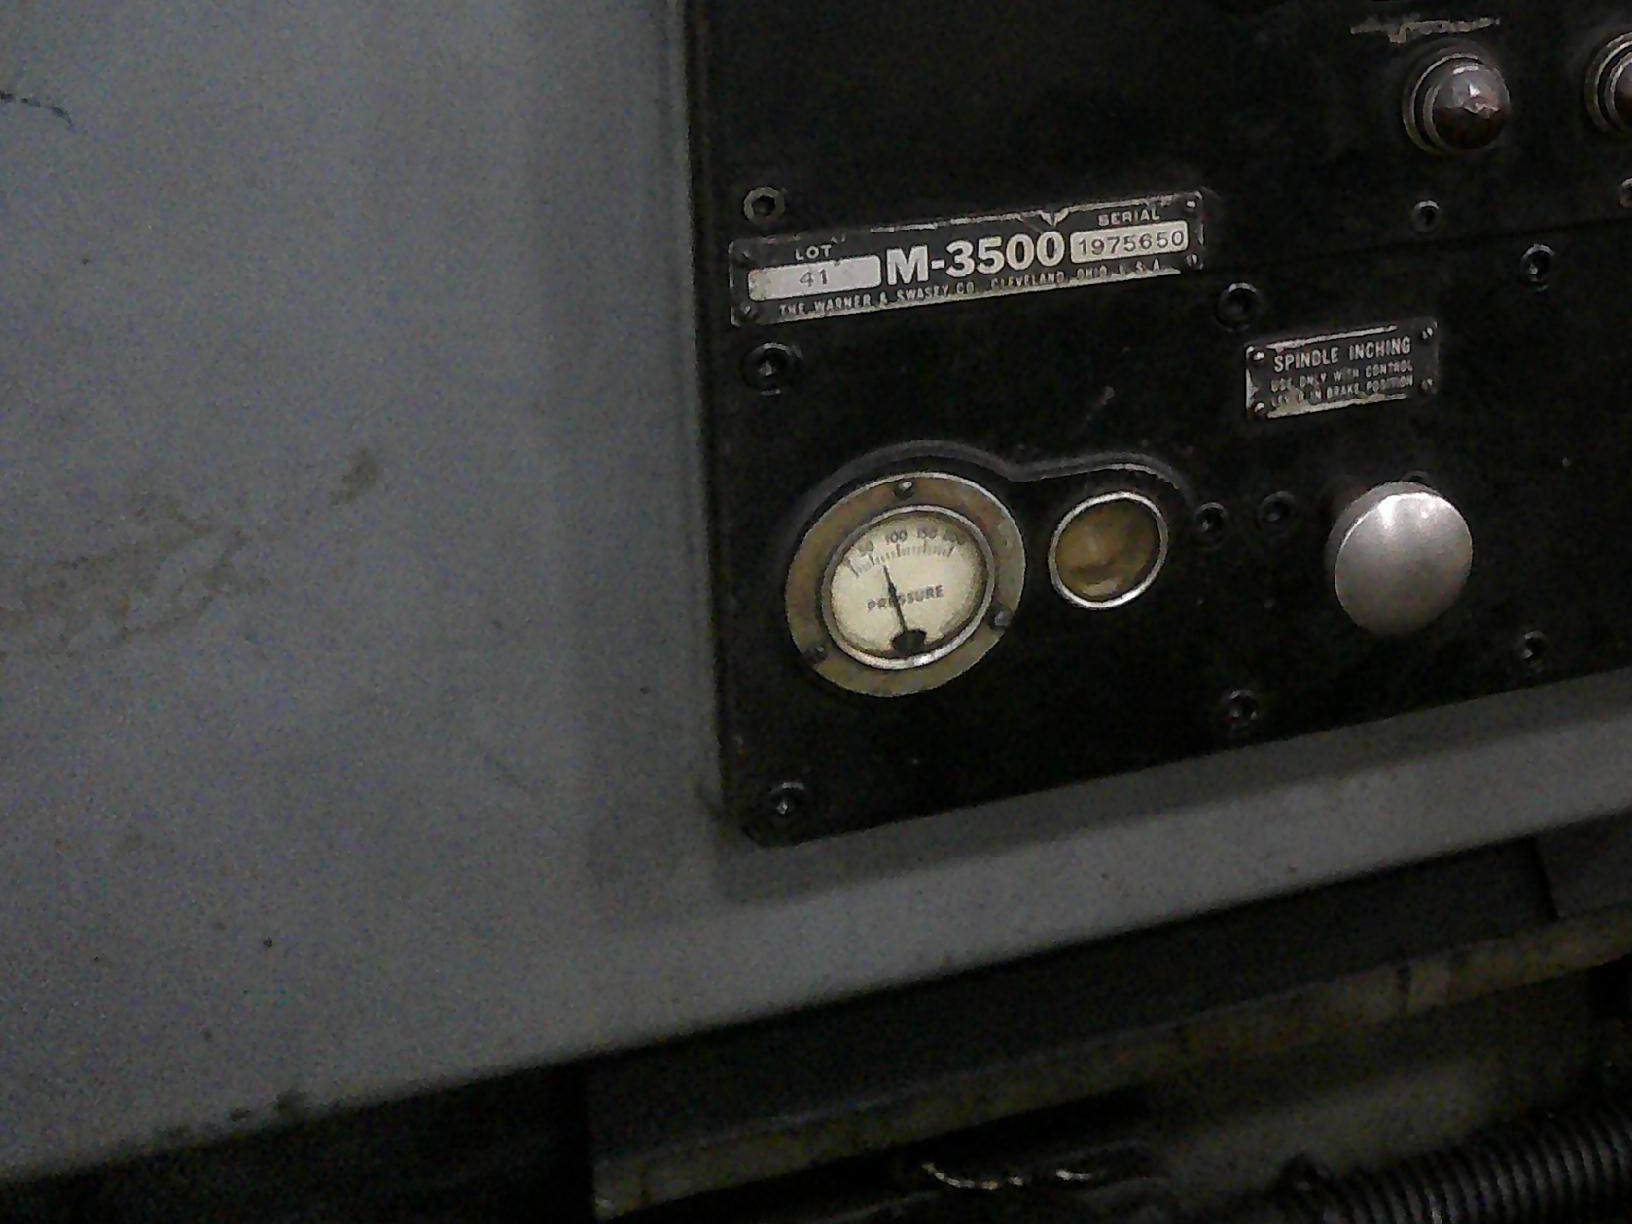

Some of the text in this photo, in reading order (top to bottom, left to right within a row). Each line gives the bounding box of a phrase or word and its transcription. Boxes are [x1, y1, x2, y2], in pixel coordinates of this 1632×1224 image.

[1098, 208, 1160, 226] SERIAL
[796, 244, 832, 261] LOT
[1078, 229, 1185, 256] 1975650
[886, 230, 1065, 286] M-3500
[799, 268, 828, 288] 41
[813, 294, 873, 314] WARNER
[897, 284, 949, 303] SWASEY
[1273, 336, 1411, 373] SPINDLE INCHING
[1366, 360, 1414, 378] CONTROL
[885, 528, 909, 546] 100
